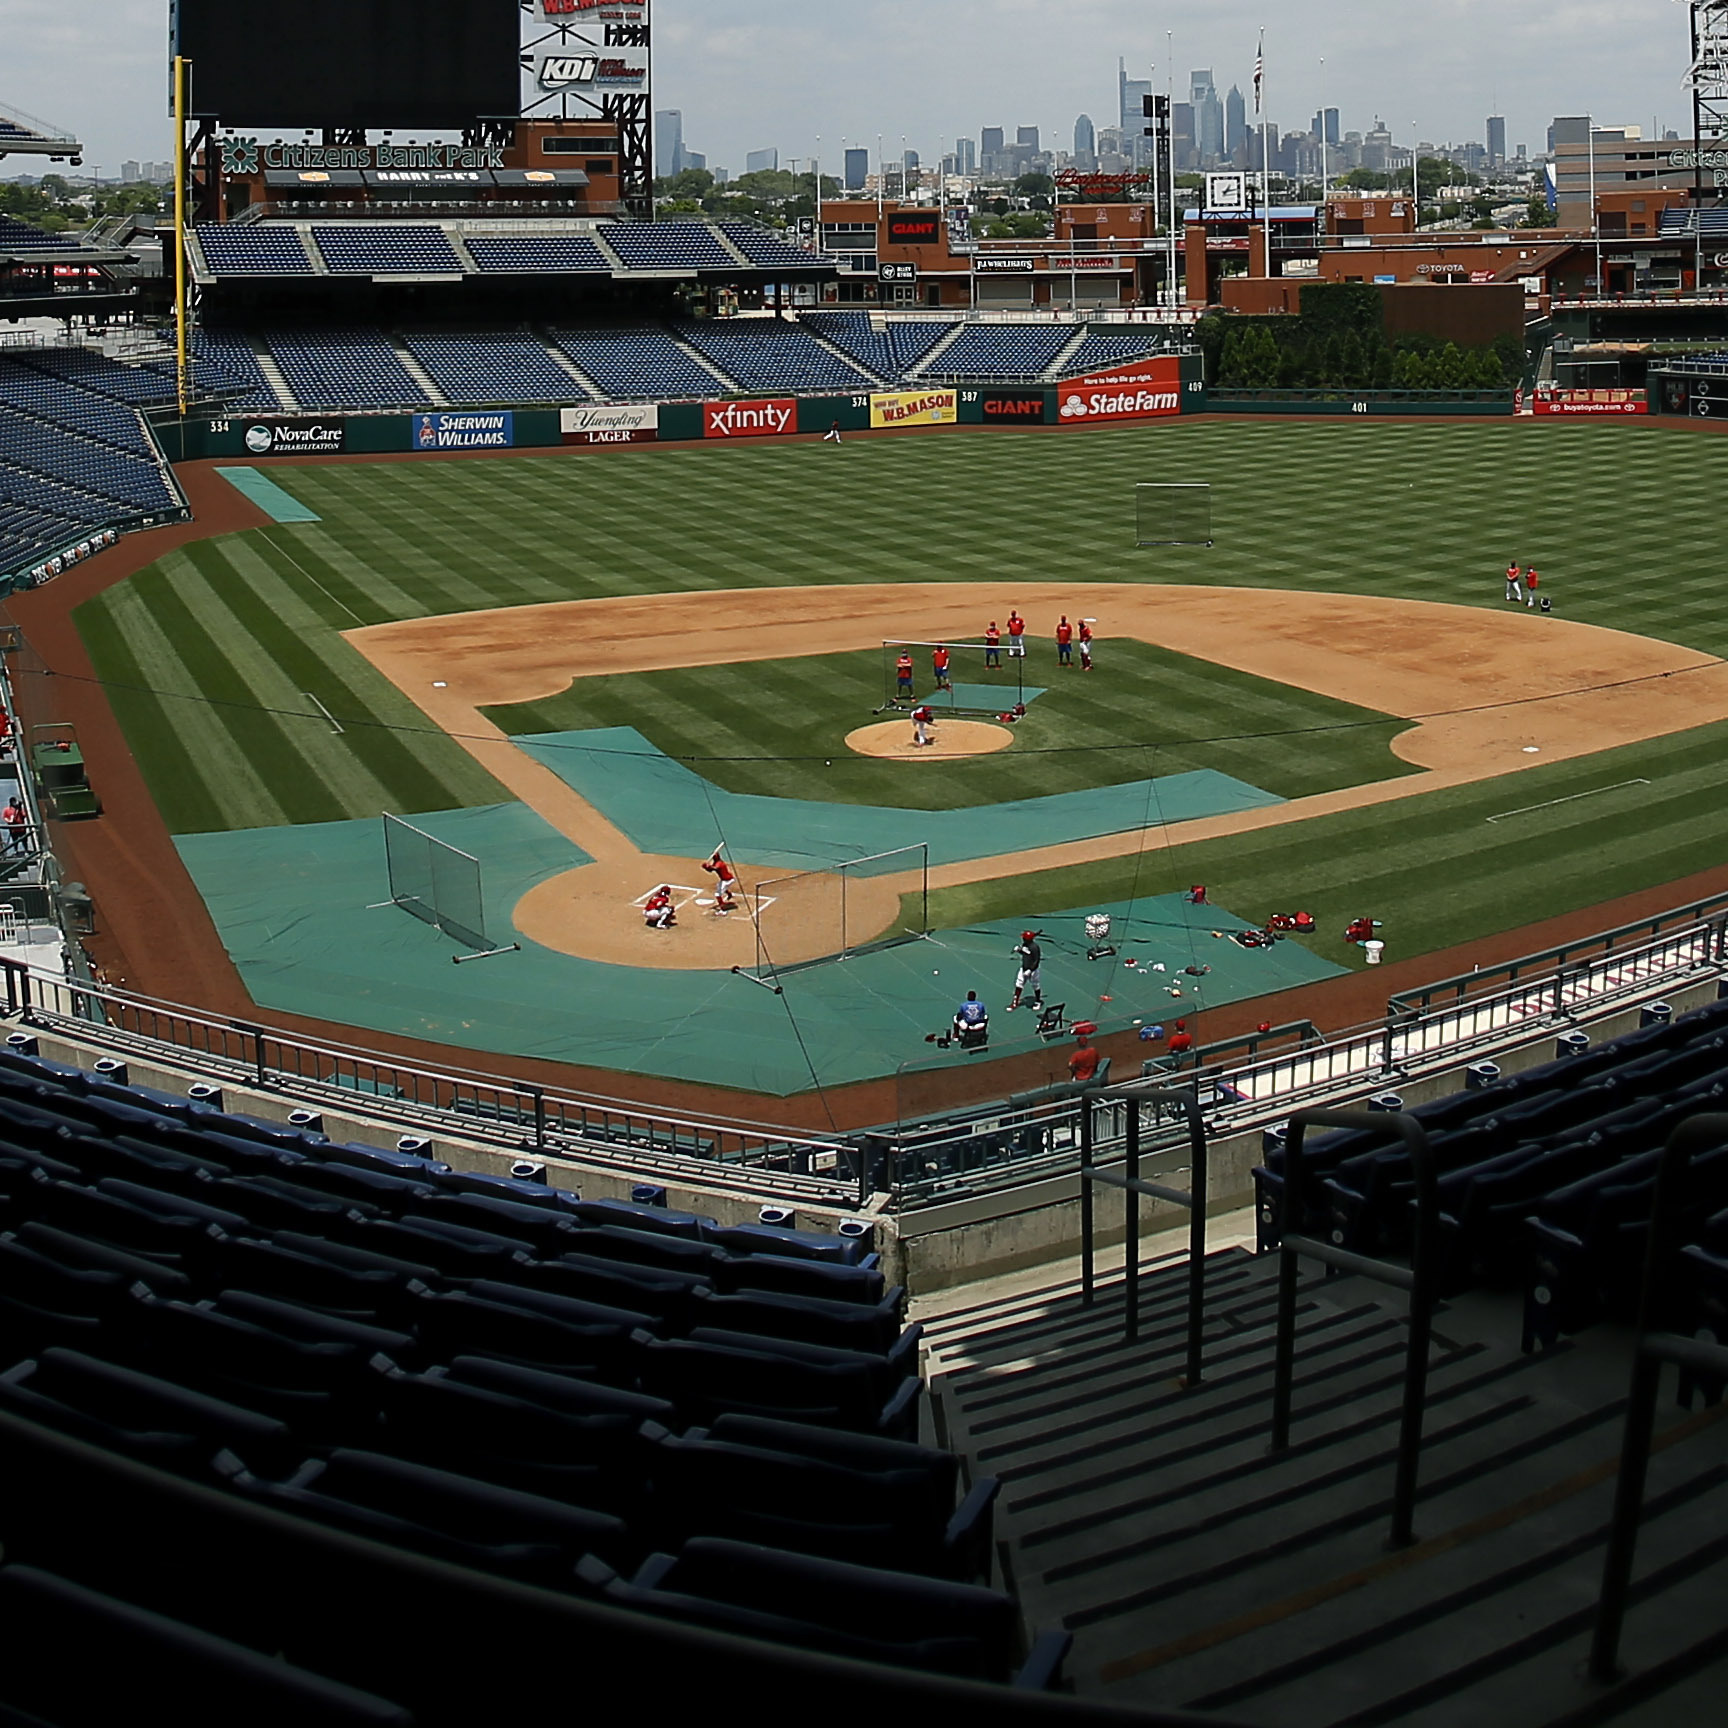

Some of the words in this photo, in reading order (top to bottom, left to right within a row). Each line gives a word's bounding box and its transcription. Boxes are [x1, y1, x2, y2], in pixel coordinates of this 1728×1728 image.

[264, 143, 370, 168] Citizens
[376, 142, 442, 168] Bank
[446, 144, 505, 169] Park
[377, 172, 429, 181] HARRY
[454, 172, 479, 181] K'S
[892, 223, 934, 234] GIANT
[1430, 264, 1465, 272] TOYOTA
[1188, 381, 1203, 392] 409
[852, 396, 868, 408] 374
[961, 391, 977, 402] 387
[984, 400, 1043, 414] GIANT
[1352, 402, 1367, 413] 401
[1564, 403, 1621, 412] buyatoyota.com
[439, 415, 504, 431] SHERWIN
[573, 409, 647, 431] Yuengling
[710, 404, 792, 435] xfinity
[210, 421, 229, 432] 334
[273, 425, 342, 442] NovaCare
[589, 431, 631, 443] LAGER
[274, 442, 339, 451] REHABILITATION
